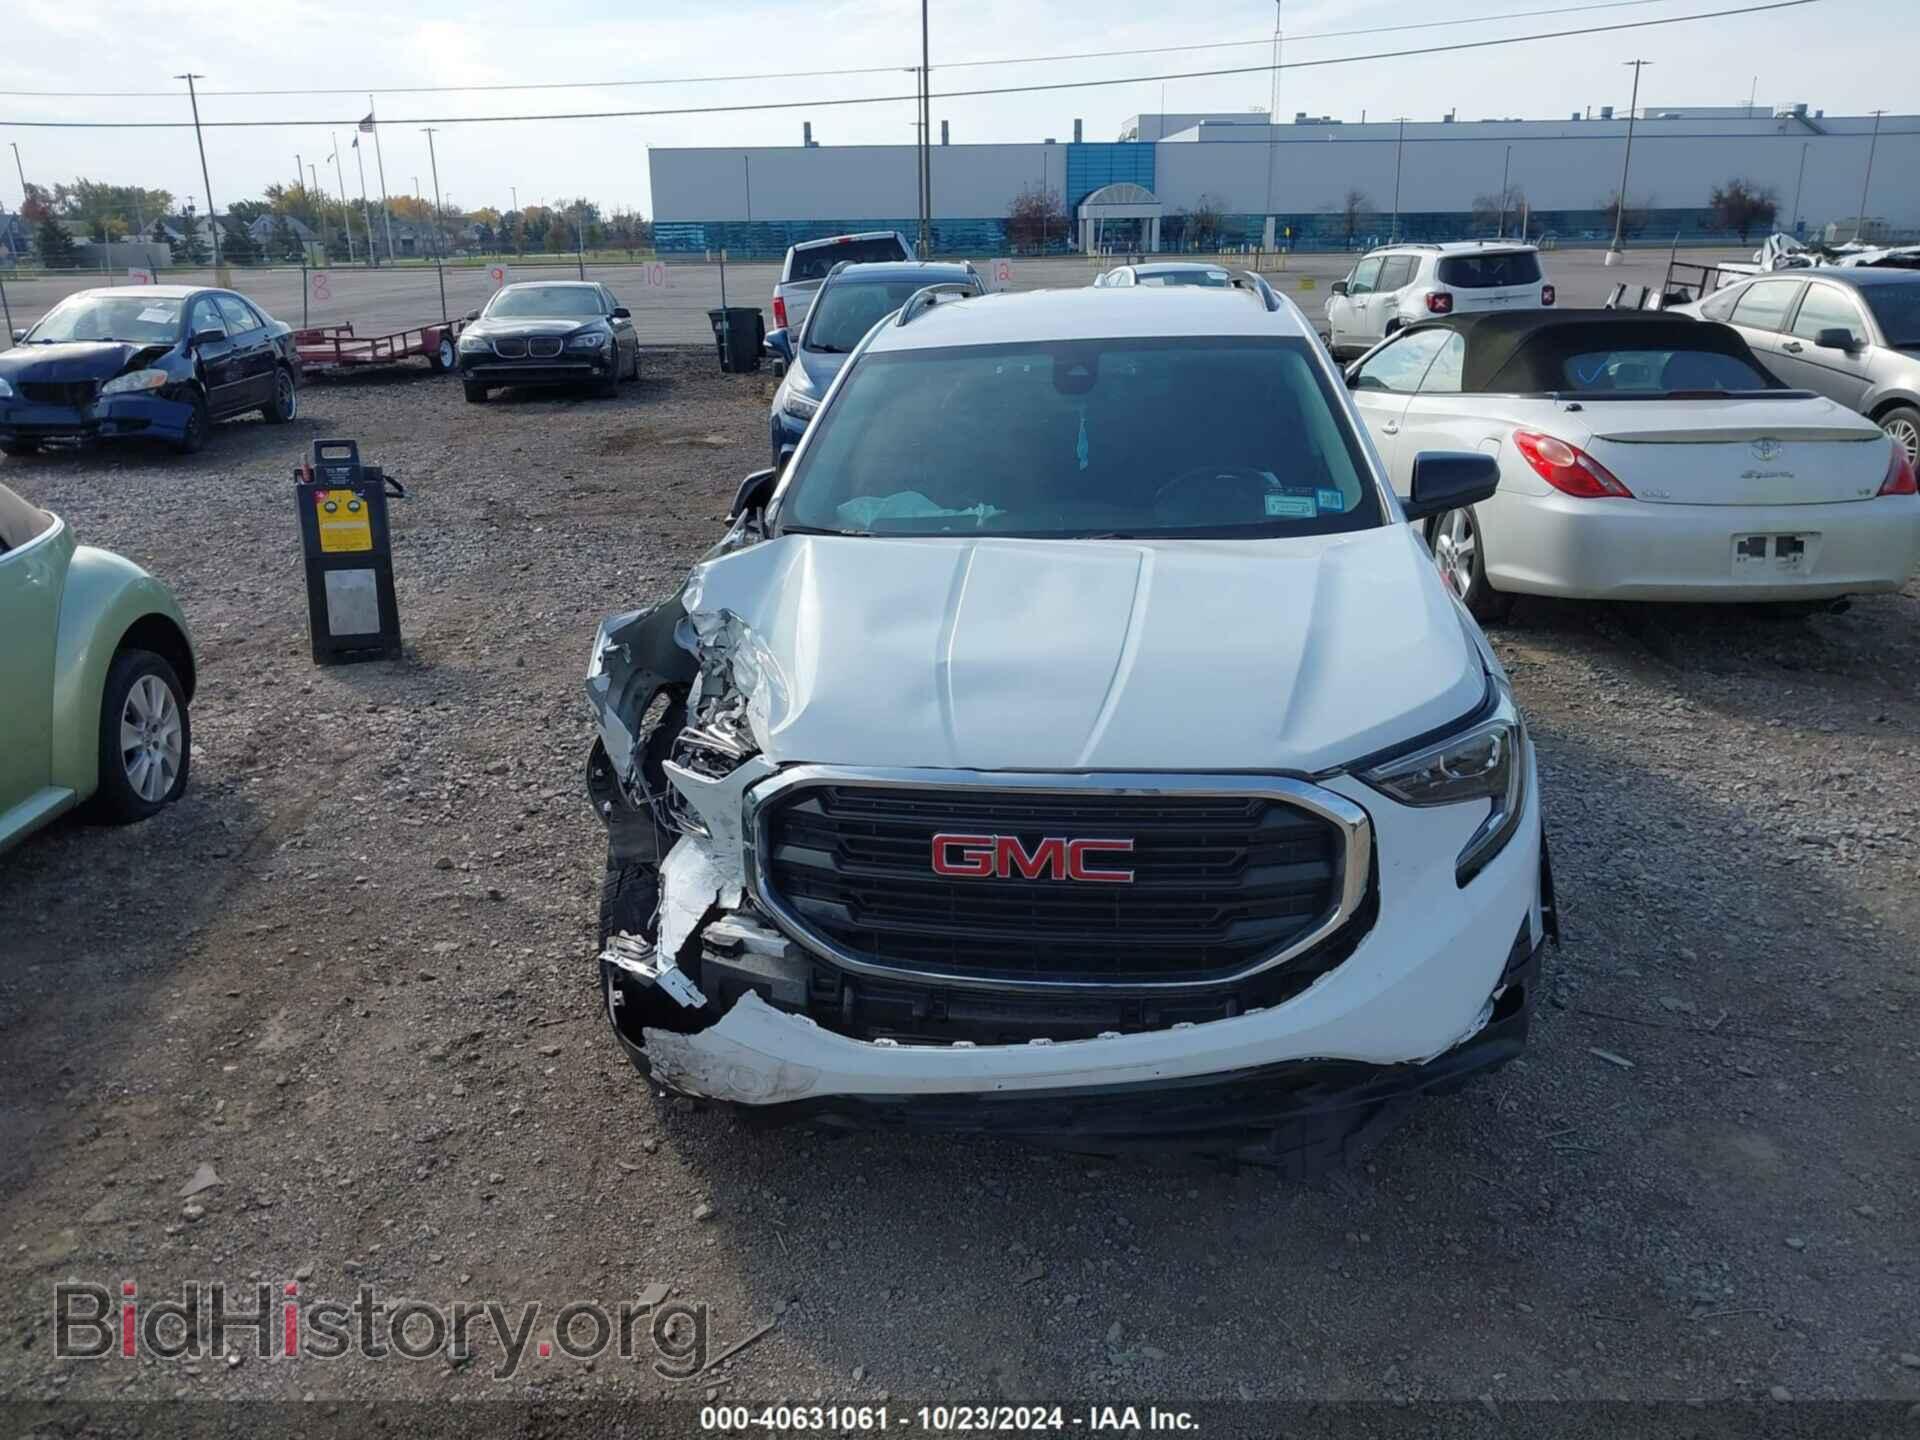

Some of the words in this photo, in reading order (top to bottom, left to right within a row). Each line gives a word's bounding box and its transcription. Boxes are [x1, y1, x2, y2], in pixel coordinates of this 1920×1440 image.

[491, 267, 503, 288] 9
[647, 264, 664, 287] 10
[993, 262, 1010, 283] 12
[312, 273, 329, 300] 8
[932, 833, 1135, 883] GMC
